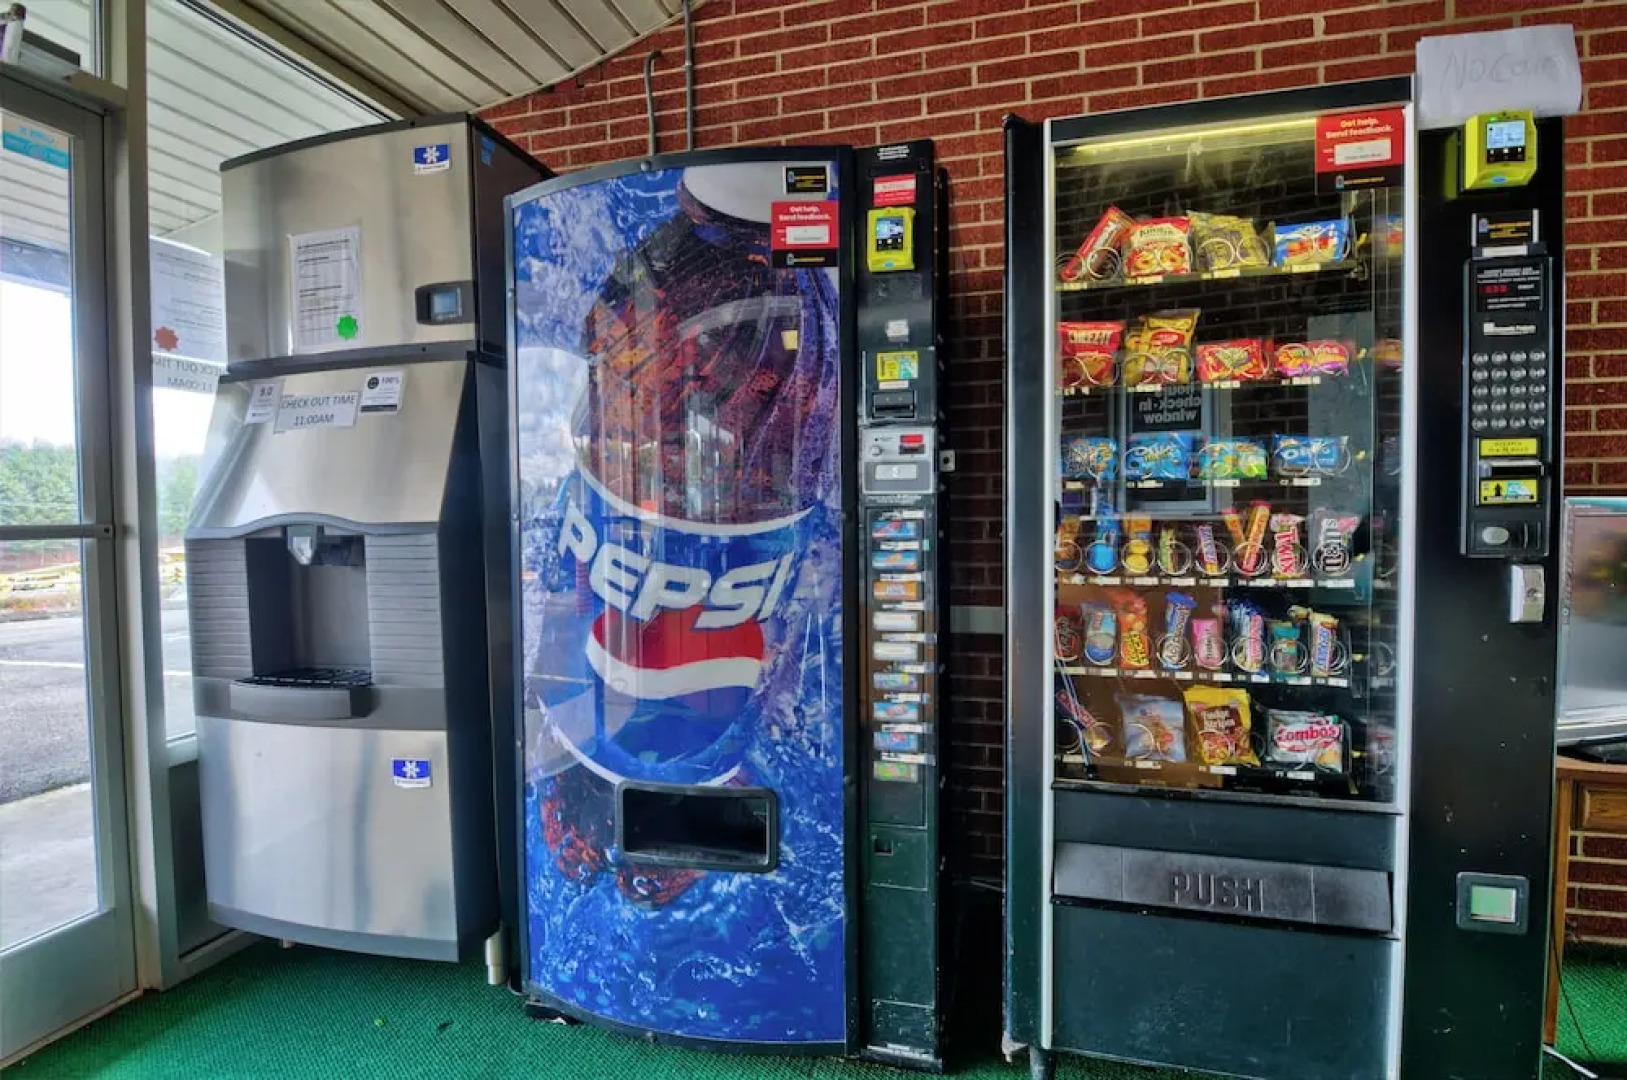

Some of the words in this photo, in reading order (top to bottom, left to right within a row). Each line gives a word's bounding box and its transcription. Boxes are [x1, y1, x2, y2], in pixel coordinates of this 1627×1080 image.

[1341, 119, 1356, 128] Get
[1357, 117, 1379, 128] help.
[1326, 129, 1348, 138] Send
[1350, 124, 1395, 137] feedback.
[789, 205, 802, 213] Get
[779, 213, 796, 222] Send
[281, 398, 307, 409] CHECK
[310, 396, 330, 407] OUT
[333, 394, 354, 405] TIME
[558, 499, 795, 629] PEPSI
[1275, 726, 1338, 744] Combos
[1171, 871, 1265, 913] PUSH
